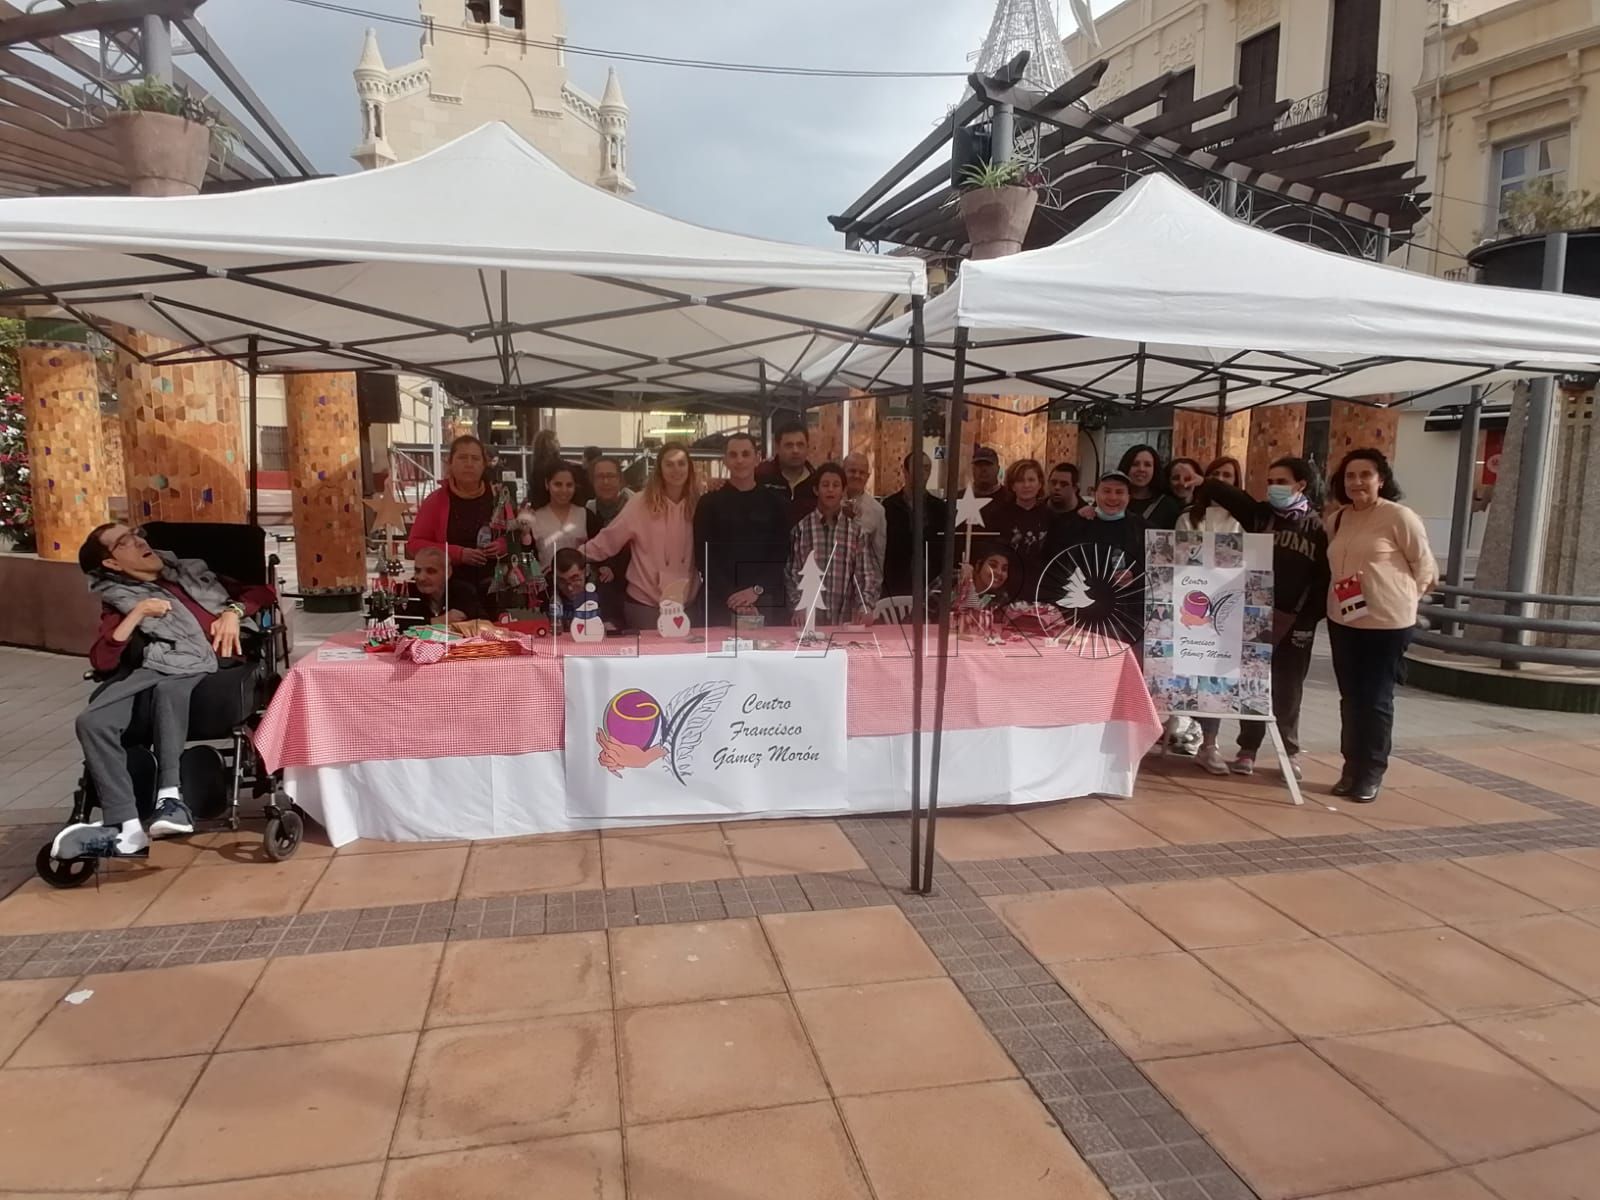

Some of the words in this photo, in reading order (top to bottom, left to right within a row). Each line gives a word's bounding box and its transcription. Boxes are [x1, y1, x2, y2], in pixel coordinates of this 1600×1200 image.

[1181, 576, 1208, 586] Centro
[1180, 636, 1215, 646] Francisco
[742, 693, 792, 714] Centro
[729, 720, 802, 741] Francisco
[712, 746, 762, 770] Gámez
[768, 745, 821, 762] Morón
